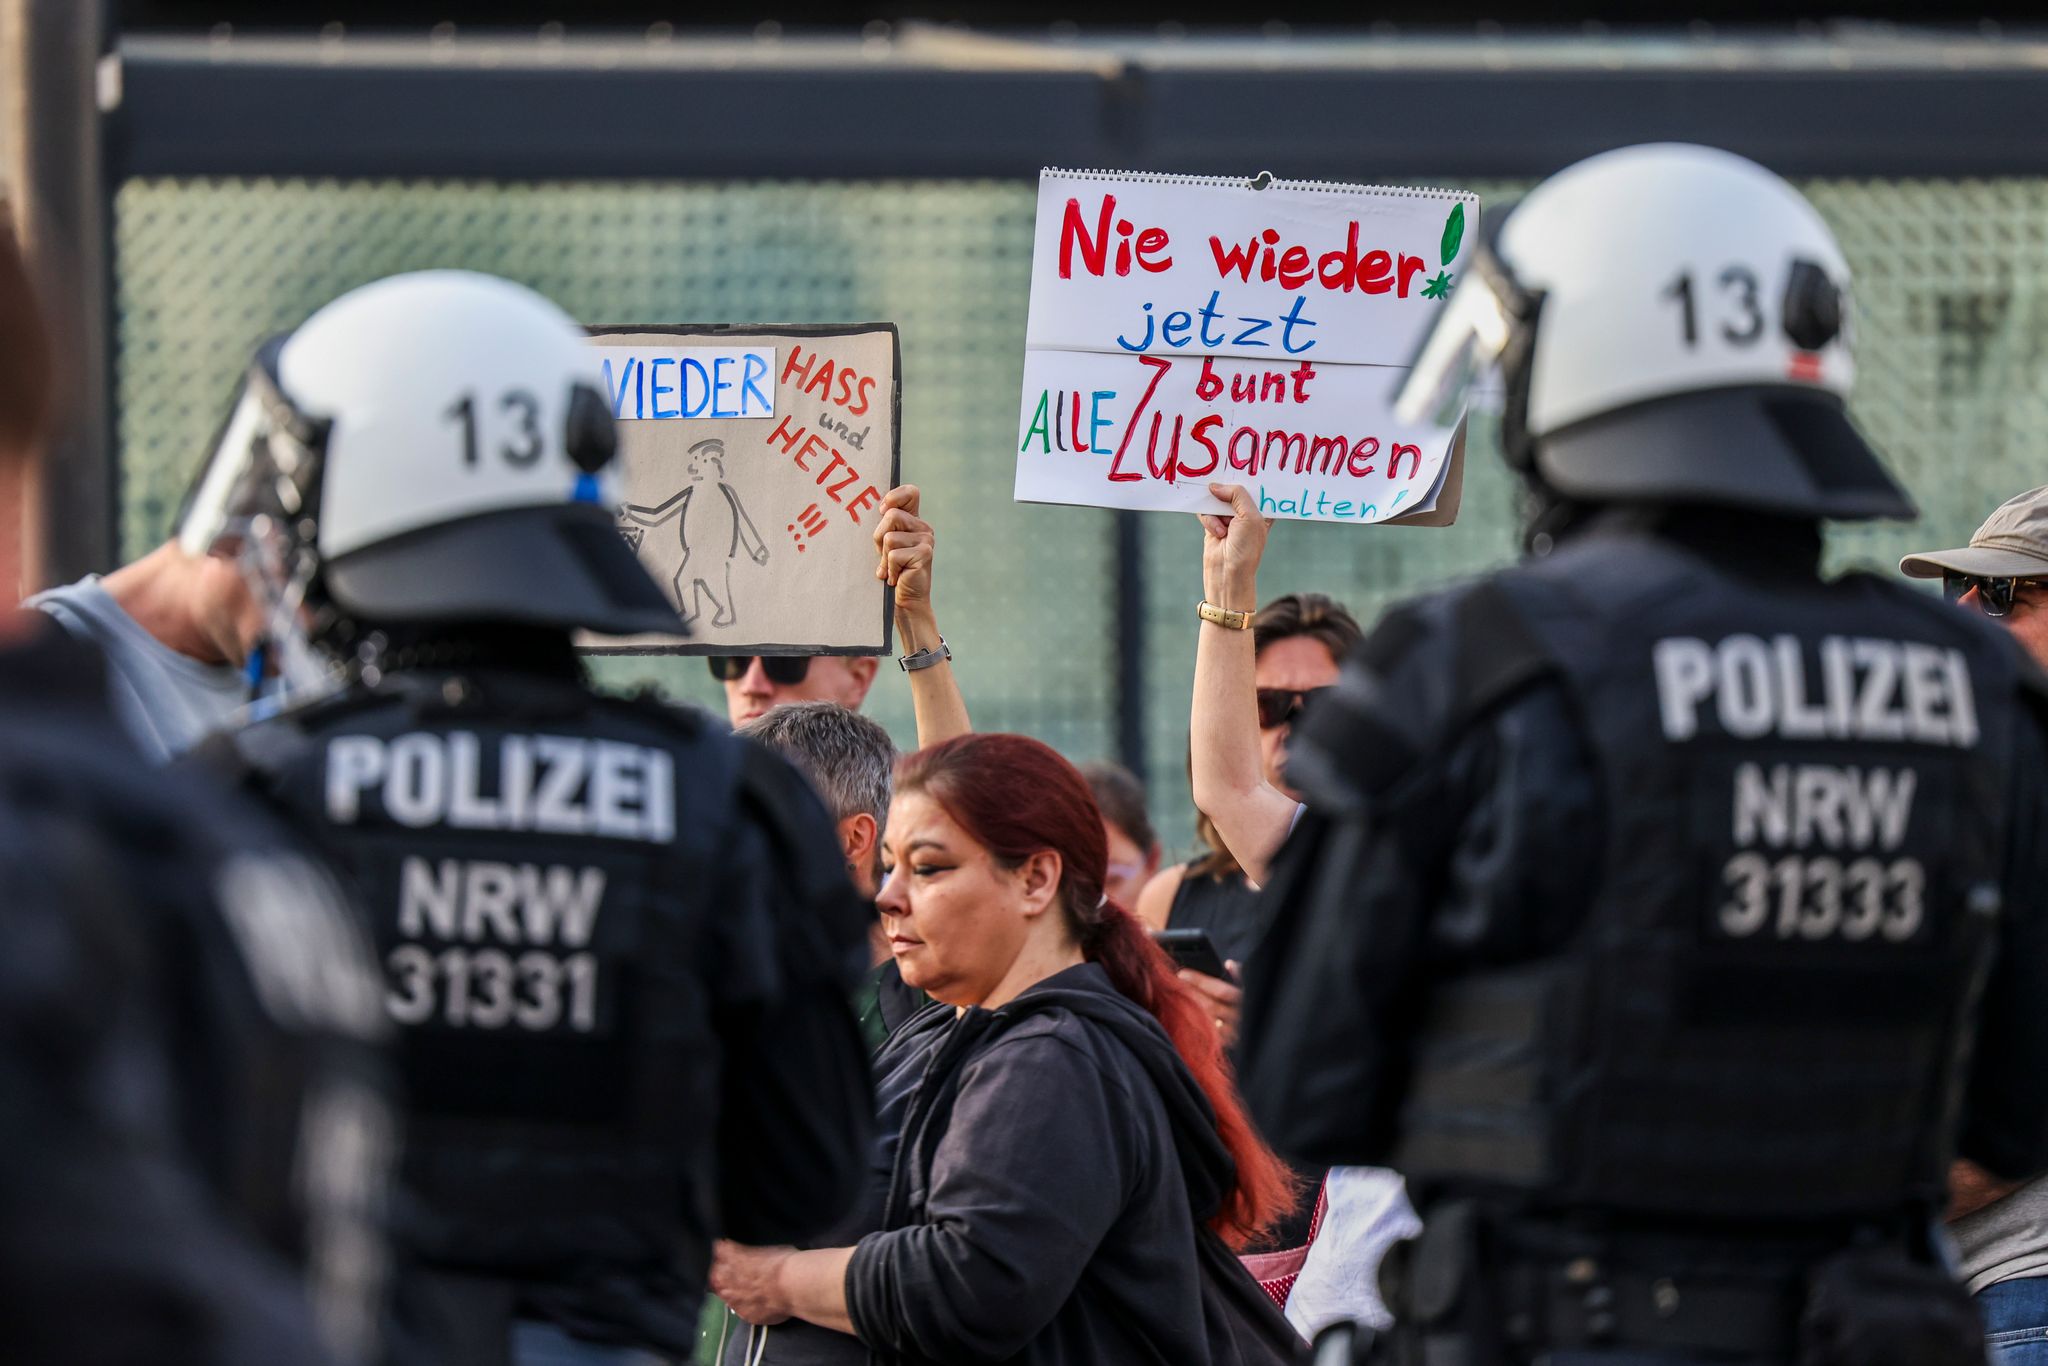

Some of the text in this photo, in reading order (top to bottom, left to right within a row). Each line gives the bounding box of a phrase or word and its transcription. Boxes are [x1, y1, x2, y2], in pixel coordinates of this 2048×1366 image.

[1059, 194, 1173, 279] Nie
[1117, 291, 1317, 353] jetzt
[1660, 264, 1765, 349] 13
[781, 345, 876, 416] HASS
[1195, 355, 1316, 403] bunt
[445, 389, 545, 472] 13
[766, 414, 882, 525] HETZE
[819, 412, 870, 450] und
[1259, 485, 1408, 518] halten!
[1653, 633, 1982, 749] POLIZEI
[325, 731, 677, 844] POLIZEI
[1733, 762, 1918, 850] NRW
[398, 855, 607, 948] NRW
[1718, 850, 1926, 943] 31333
[386, 944, 601, 1034] 31331
